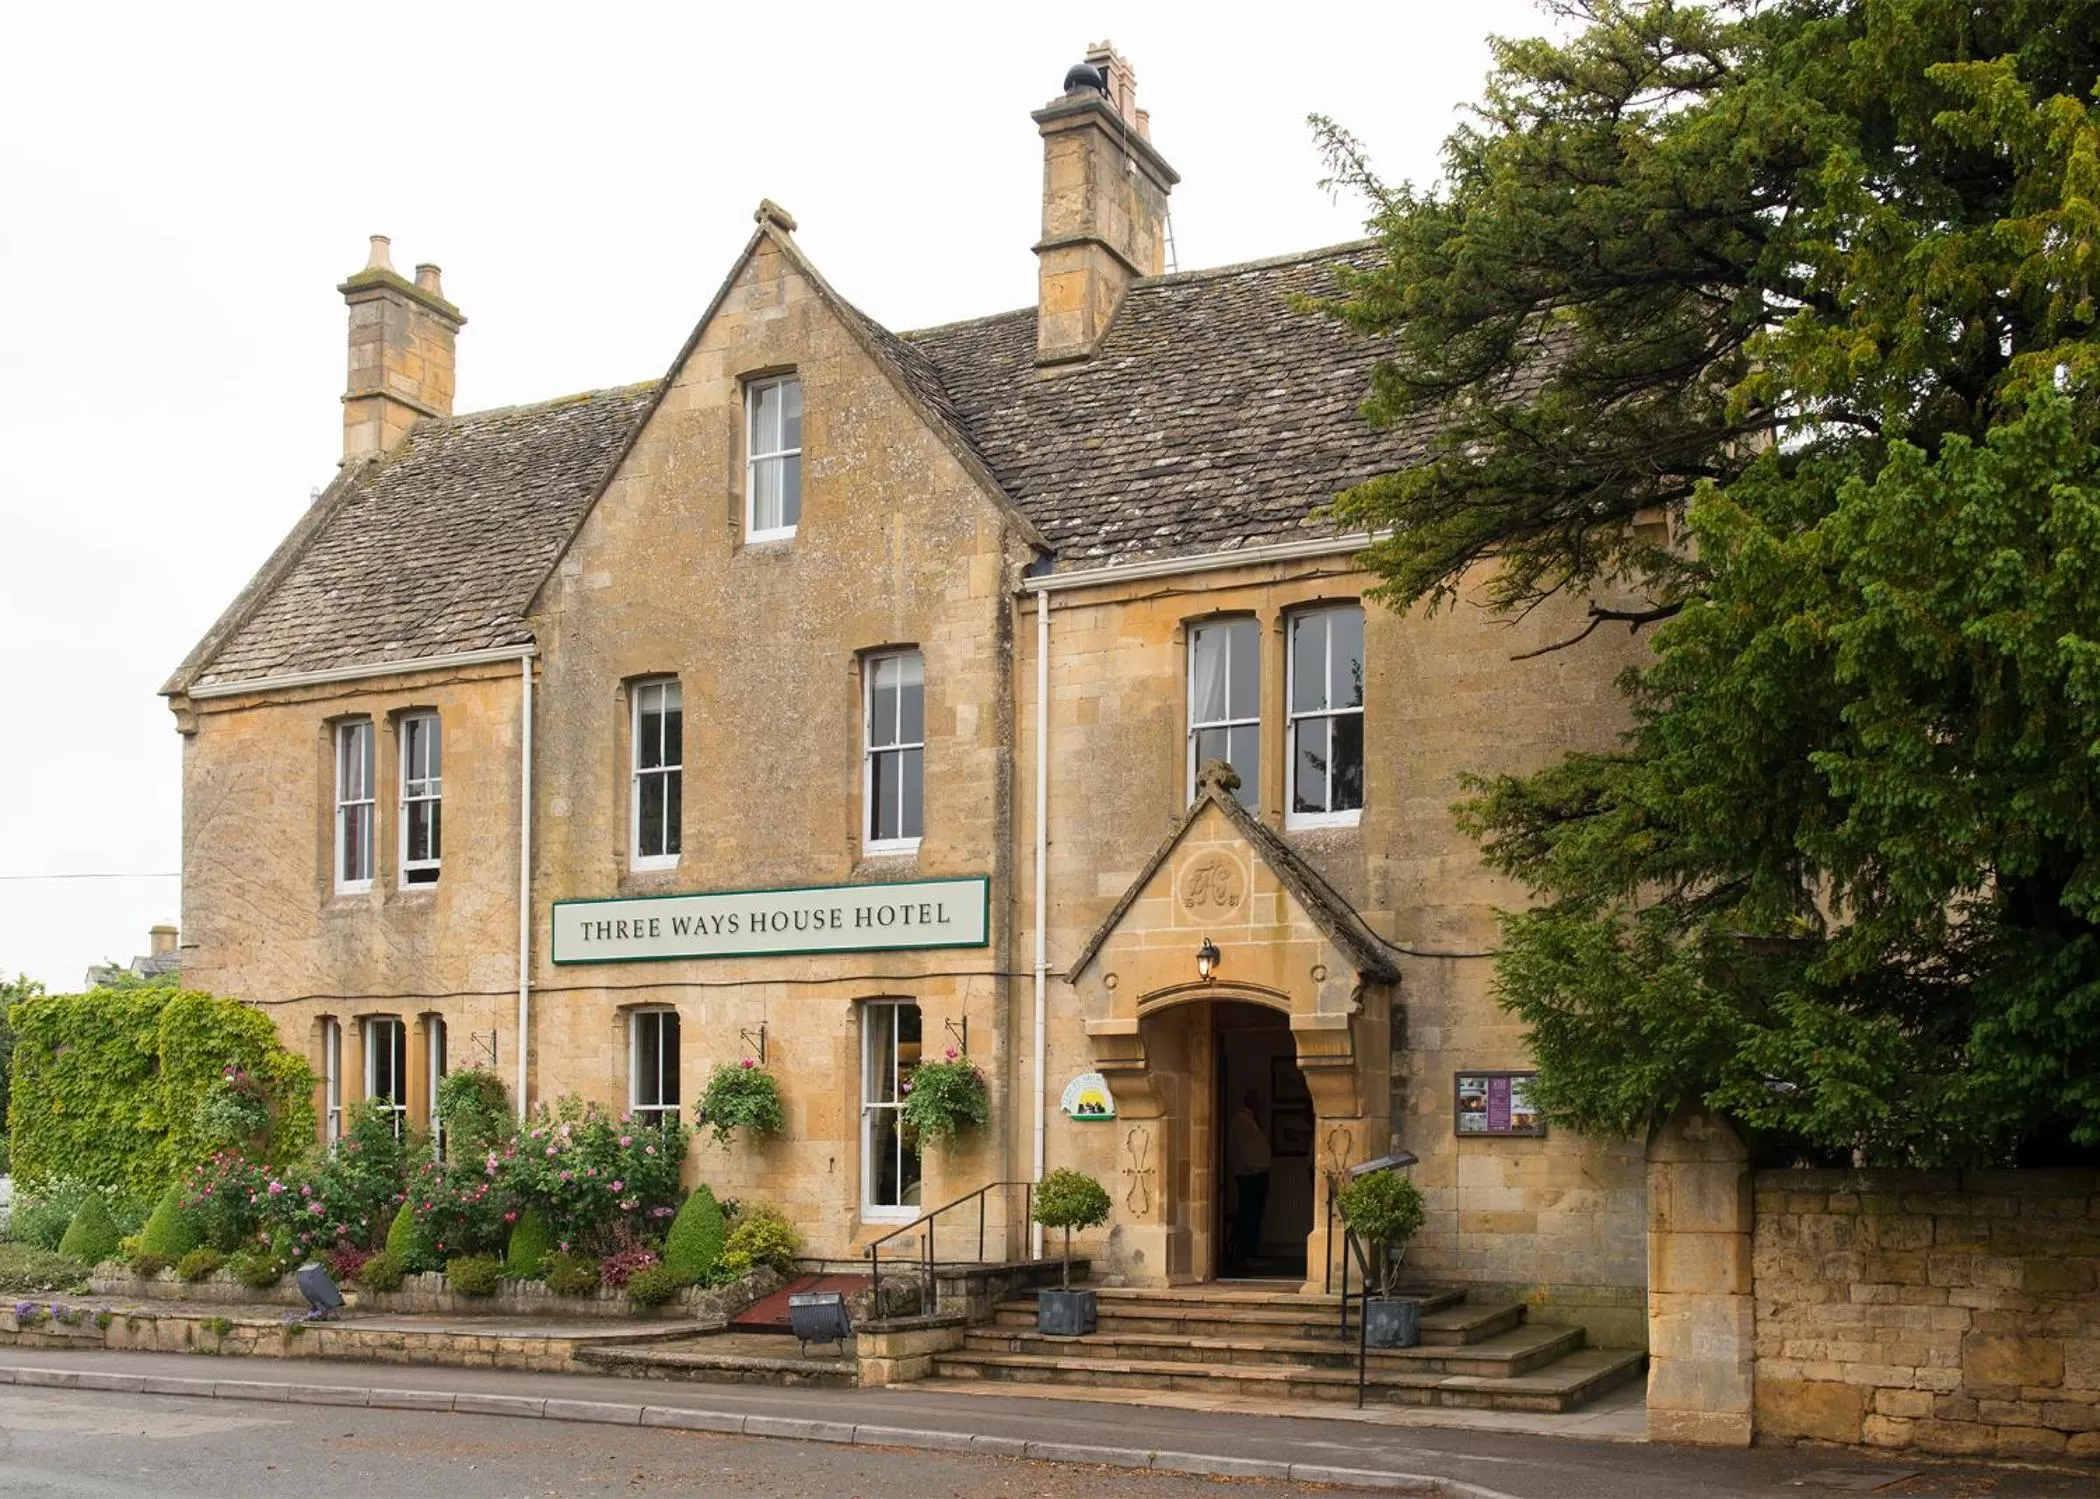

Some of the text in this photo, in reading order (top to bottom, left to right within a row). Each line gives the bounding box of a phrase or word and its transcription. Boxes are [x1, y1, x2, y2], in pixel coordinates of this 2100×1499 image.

[580, 902, 951, 941] THREE WAYS HOUSE HOTEL
